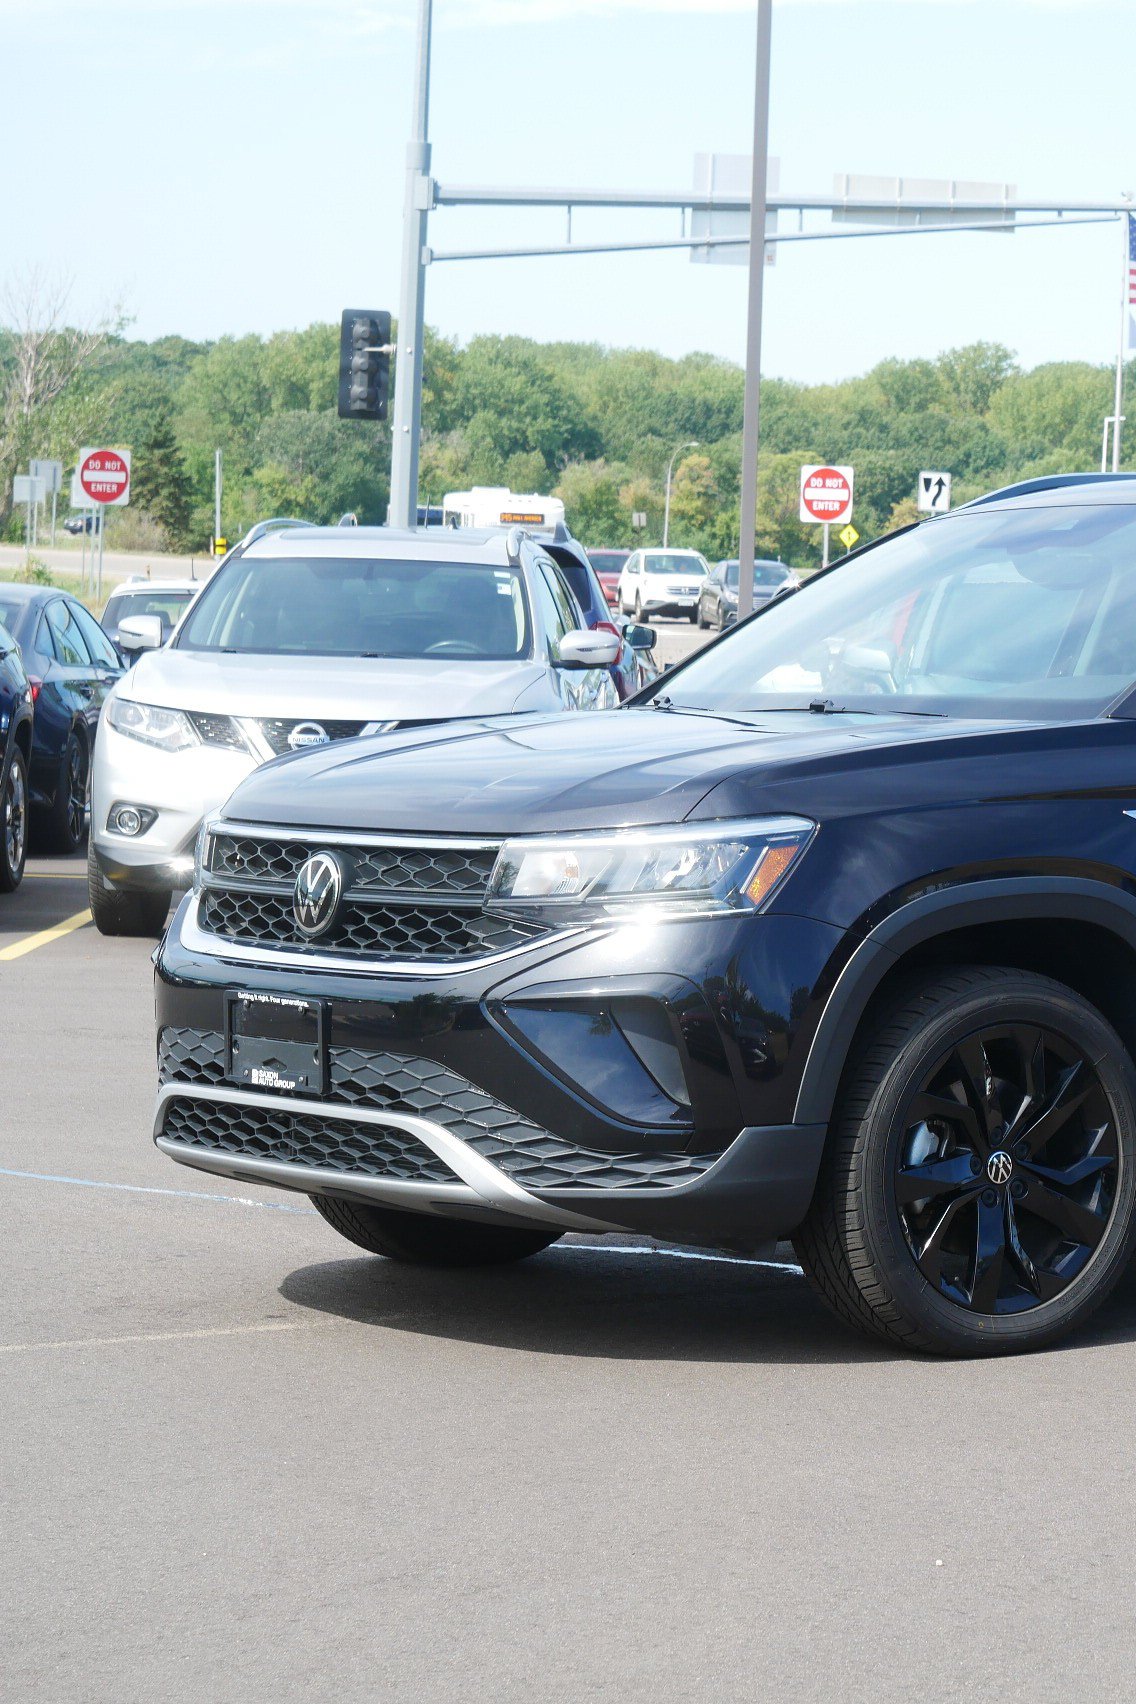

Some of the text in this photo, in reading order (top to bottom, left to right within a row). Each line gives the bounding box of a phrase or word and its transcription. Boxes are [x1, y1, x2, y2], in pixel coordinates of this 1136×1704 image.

[89, 459, 121, 471] DO NOT
[91, 482, 118, 493] ENTER
[810, 477, 843, 489] DO NOT
[812, 500, 840, 511] ENTER
[259, 1069, 279, 1080] SAXON
[258, 1077, 296, 1090] AUTO GROUP
